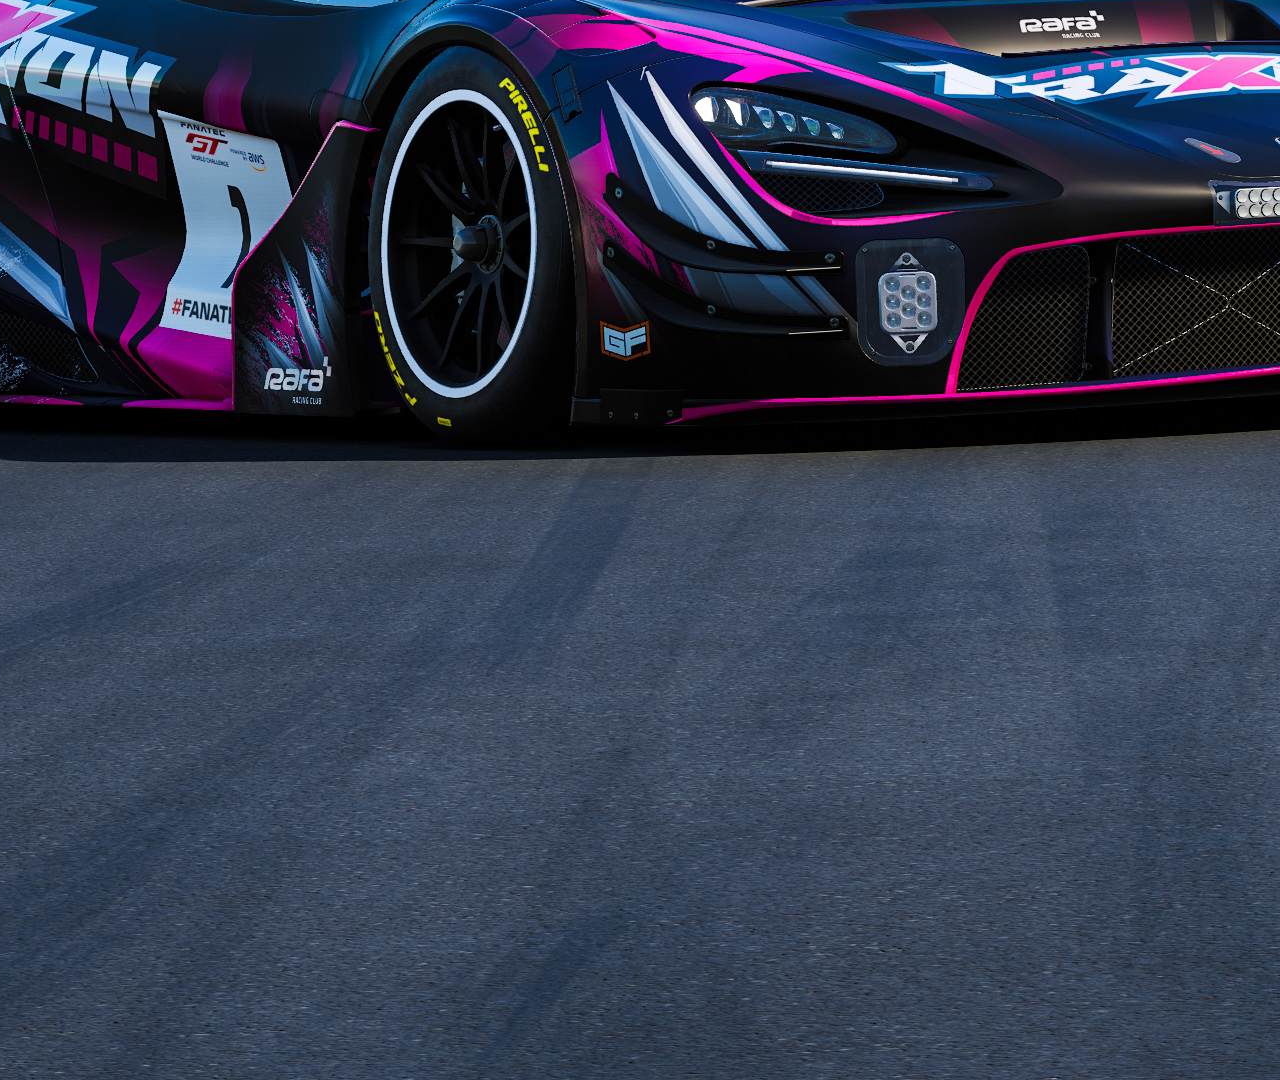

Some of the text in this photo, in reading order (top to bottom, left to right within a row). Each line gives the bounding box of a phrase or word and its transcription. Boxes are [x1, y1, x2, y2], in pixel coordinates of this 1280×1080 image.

[180, 122, 226, 137] FANATEC
[498, 77, 550, 172] PIRELLI
[185, 132, 229, 155] GT
[247, 152, 265, 165] aws
[603, 325, 647, 357] GF
[309, 397, 322, 405] CLUB
